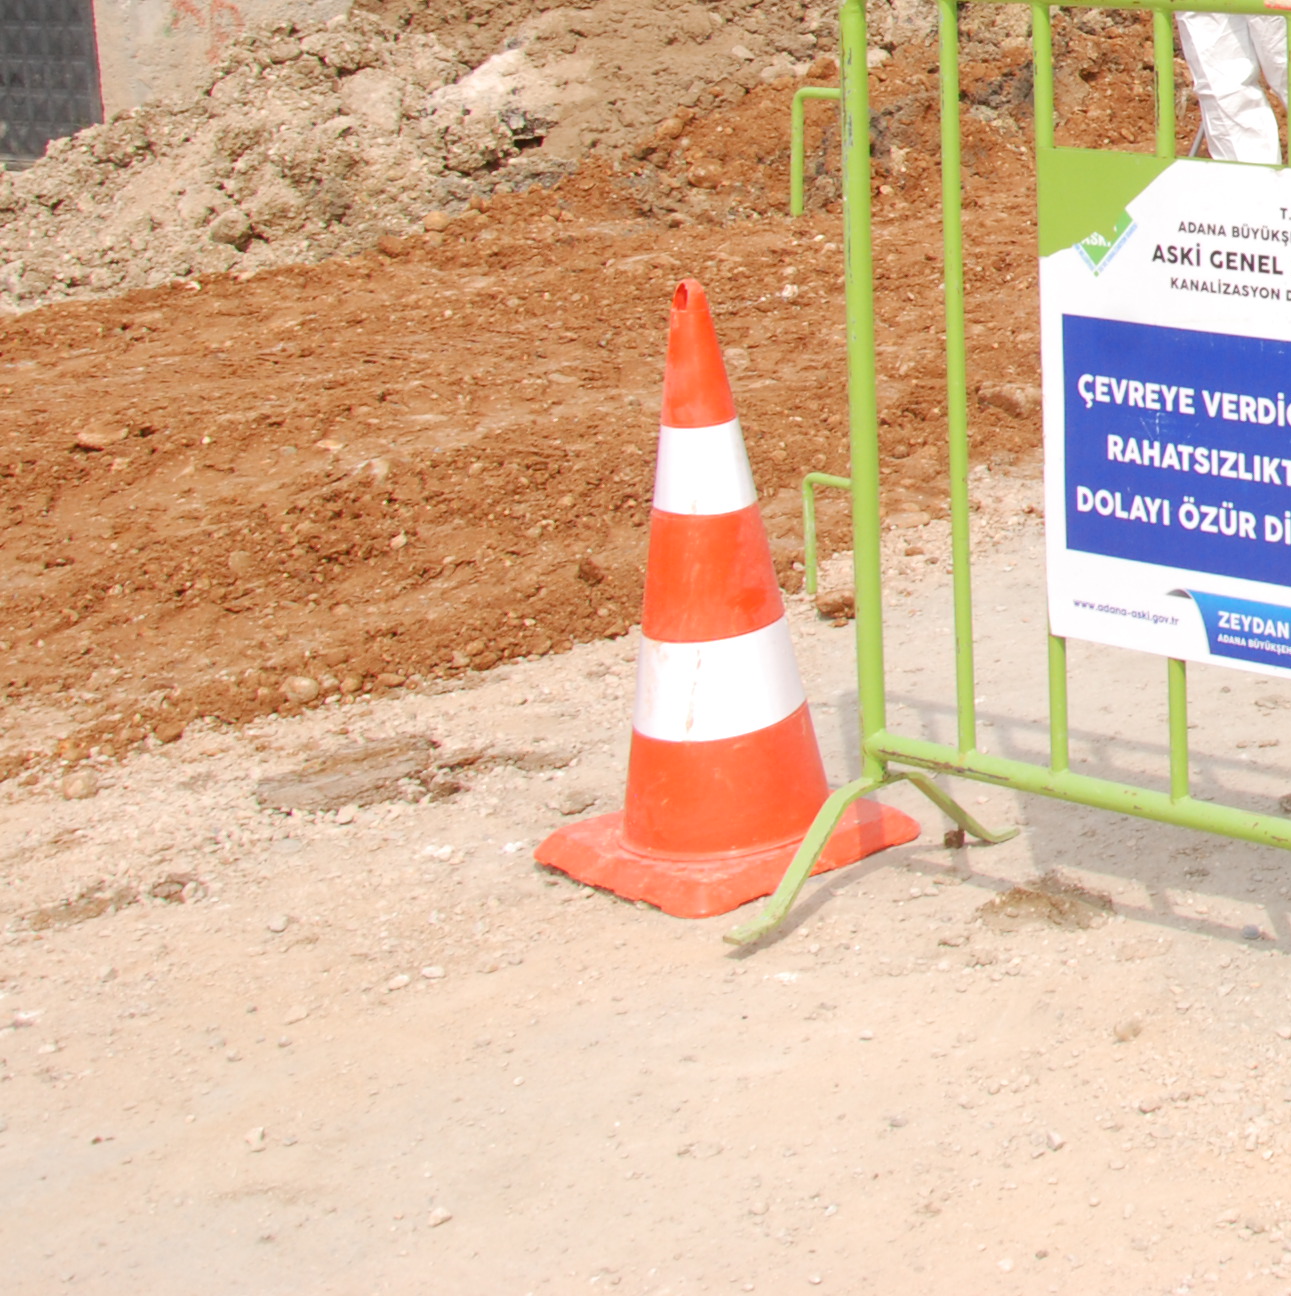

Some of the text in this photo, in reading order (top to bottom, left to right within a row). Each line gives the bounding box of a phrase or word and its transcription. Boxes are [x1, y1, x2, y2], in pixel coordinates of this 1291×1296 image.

[1178, 221, 1227, 237] ADANA
[1152, 243, 1201, 267] ASKİ
[1209, 250, 1283, 275] GENEL
[1170, 277, 1281, 300] KANALİZASYON
[1077, 373, 1195, 415] ÇEVREYE
[1076, 485, 1170, 526] DOLAYI
[1178, 495, 1257, 539] ÖZÜR
[1073, 599, 1180, 626] www.adana-aski.gov.tr
[1217, 610, 1290, 640] ZEYDAN
[1217, 633, 1247, 647] ADANA
